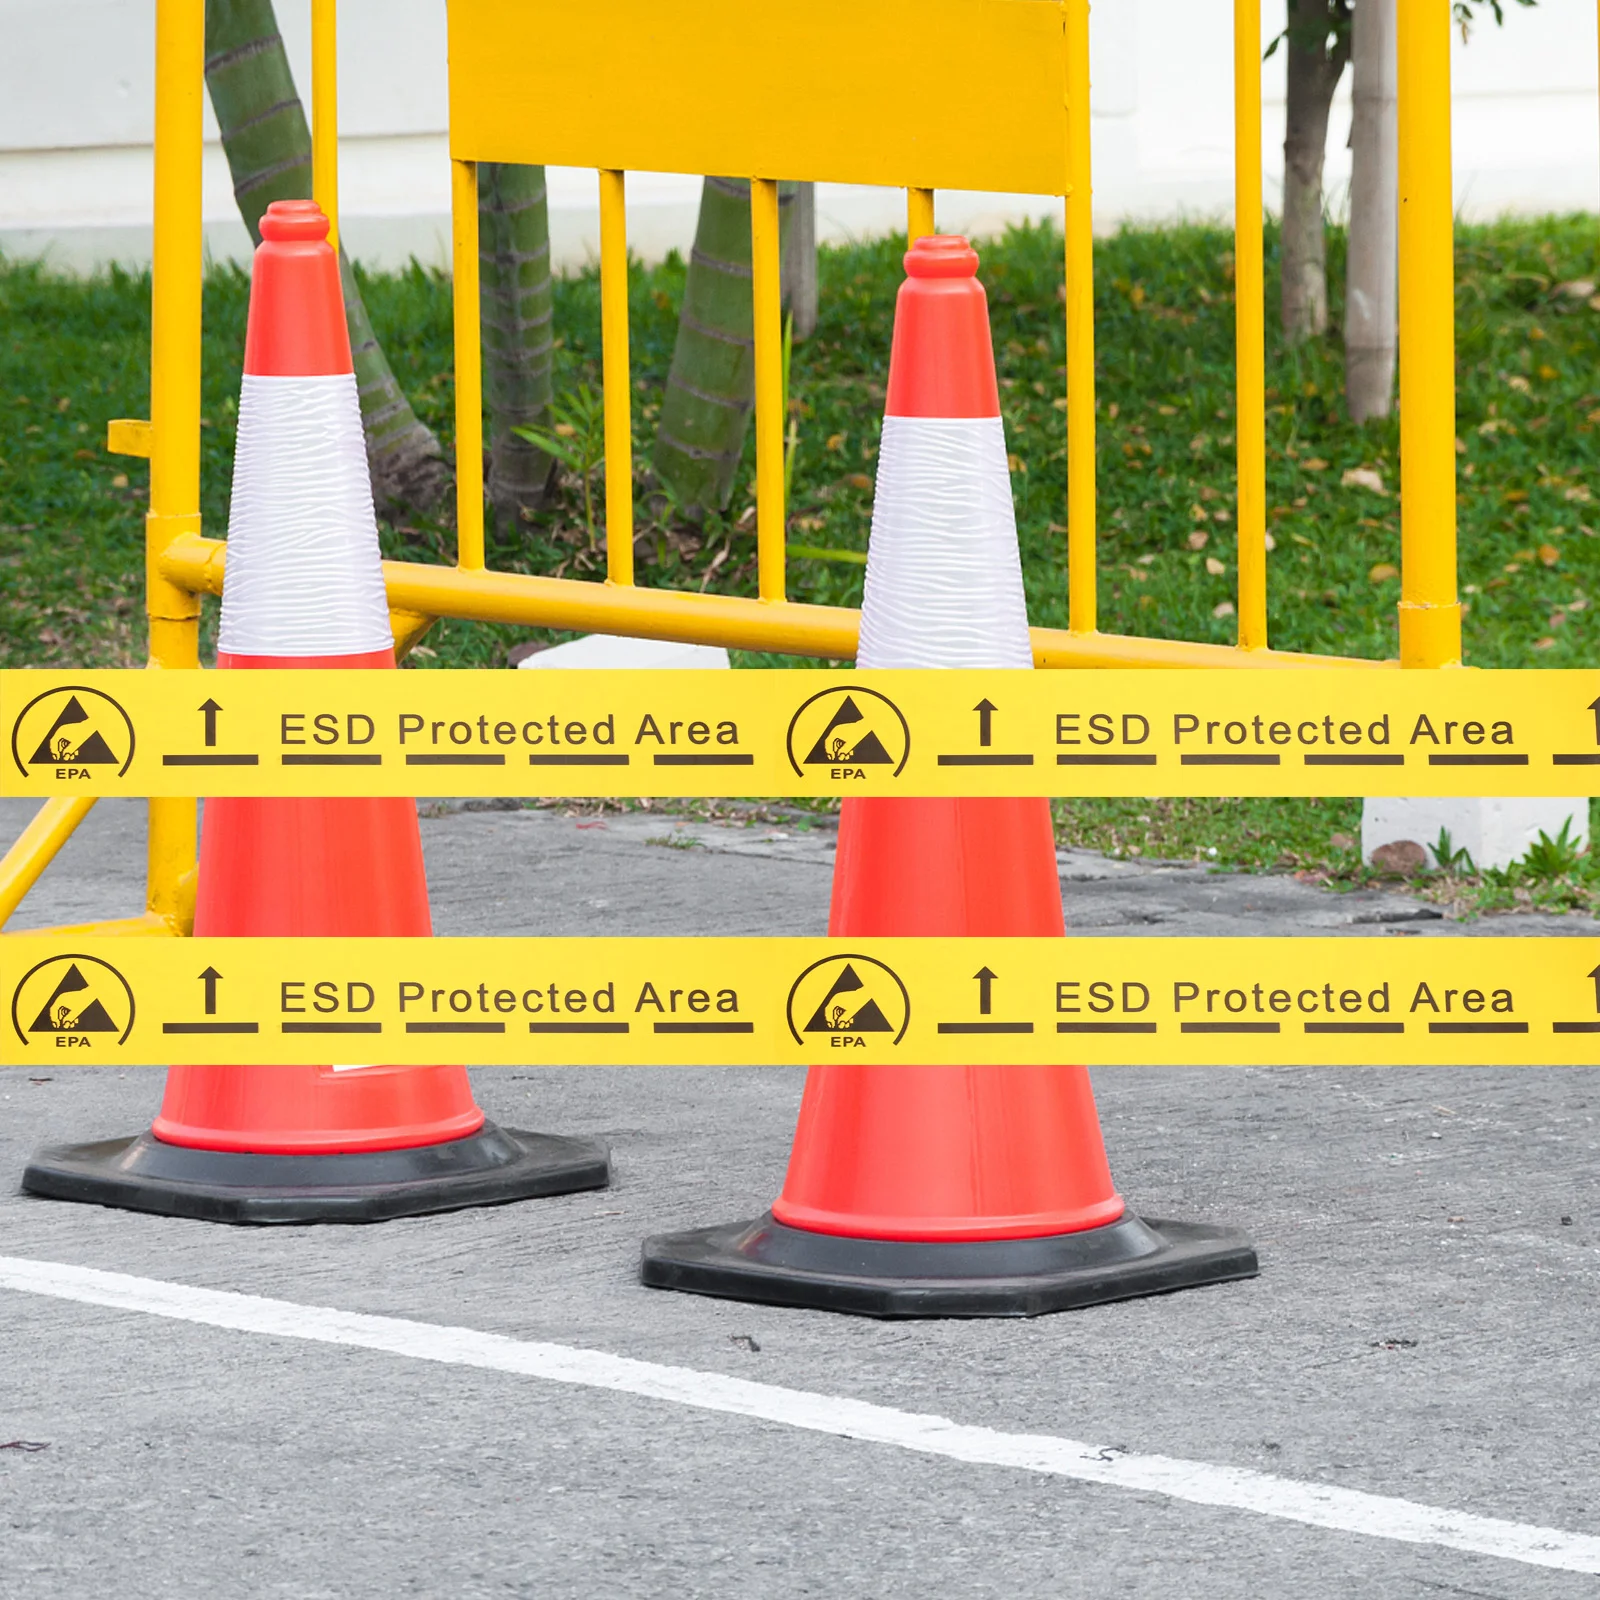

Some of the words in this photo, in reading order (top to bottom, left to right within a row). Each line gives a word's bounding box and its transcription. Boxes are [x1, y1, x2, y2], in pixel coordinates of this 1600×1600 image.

[281, 714, 375, 745] ESD
[399, 714, 615, 745] Protected
[634, 714, 740, 745] Area
[1056, 714, 1150, 745] ESD
[1174, 714, 1390, 745] Protected
[1409, 714, 1515, 745] Area
[55, 768, 91, 780] EPA
[830, 768, 866, 780] EPA
[281, 982, 375, 1013] ESD
[399, 982, 615, 1013] Protected
[634, 982, 740, 1013] Area
[1056, 982, 1150, 1013] ESD
[1174, 982, 1390, 1013] Protected
[1409, 982, 1515, 1013] Area
[55, 1036, 91, 1047] EPA
[830, 1036, 866, 1047] EPA
